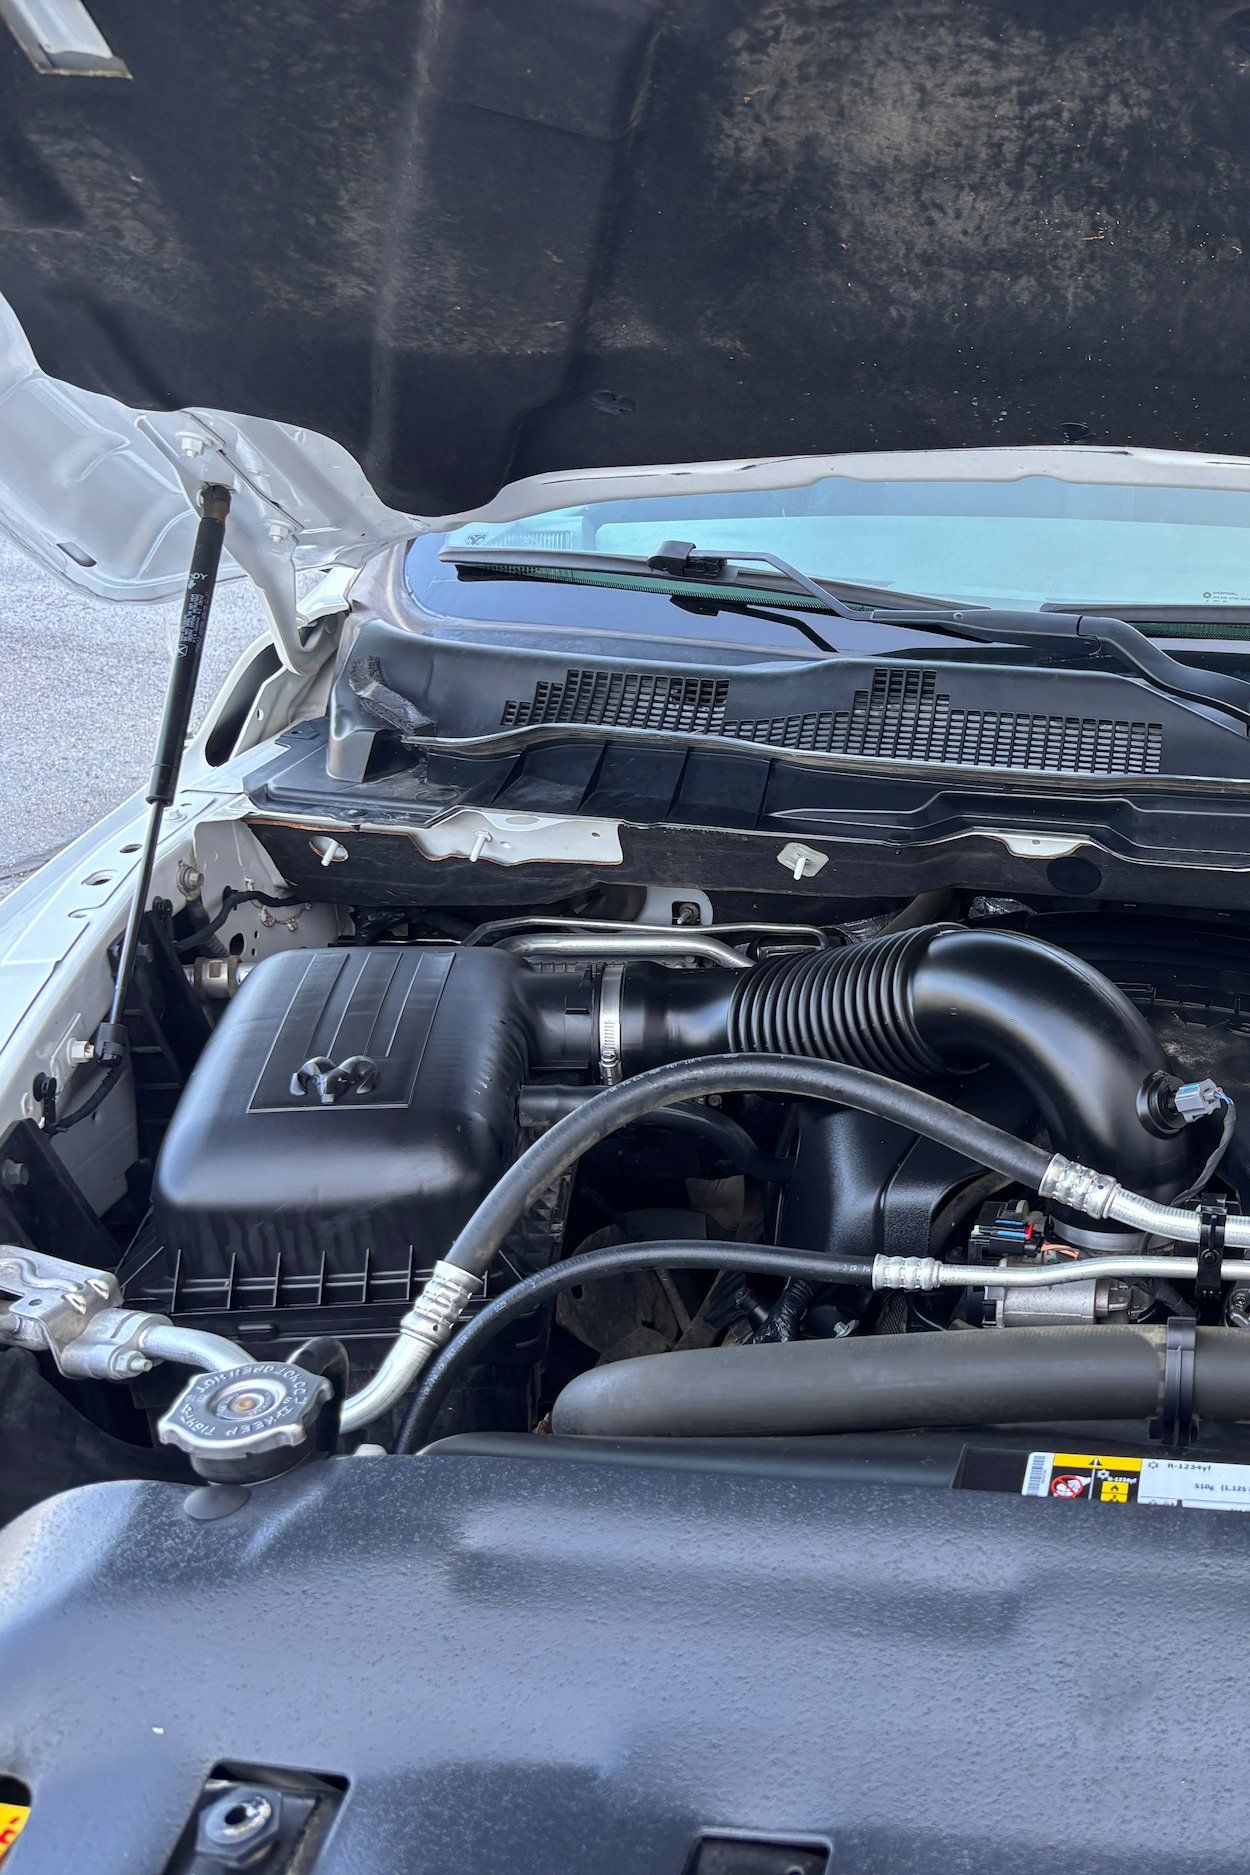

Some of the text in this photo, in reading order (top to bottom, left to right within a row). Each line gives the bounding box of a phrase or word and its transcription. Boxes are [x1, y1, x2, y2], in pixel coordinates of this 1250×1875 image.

[180, 1411, 277, 1436] KEEP TIGHT
[1167, 1462, 1212, 1472] R-1234yf
[1194, 1482, 1215, 1491] 510g
